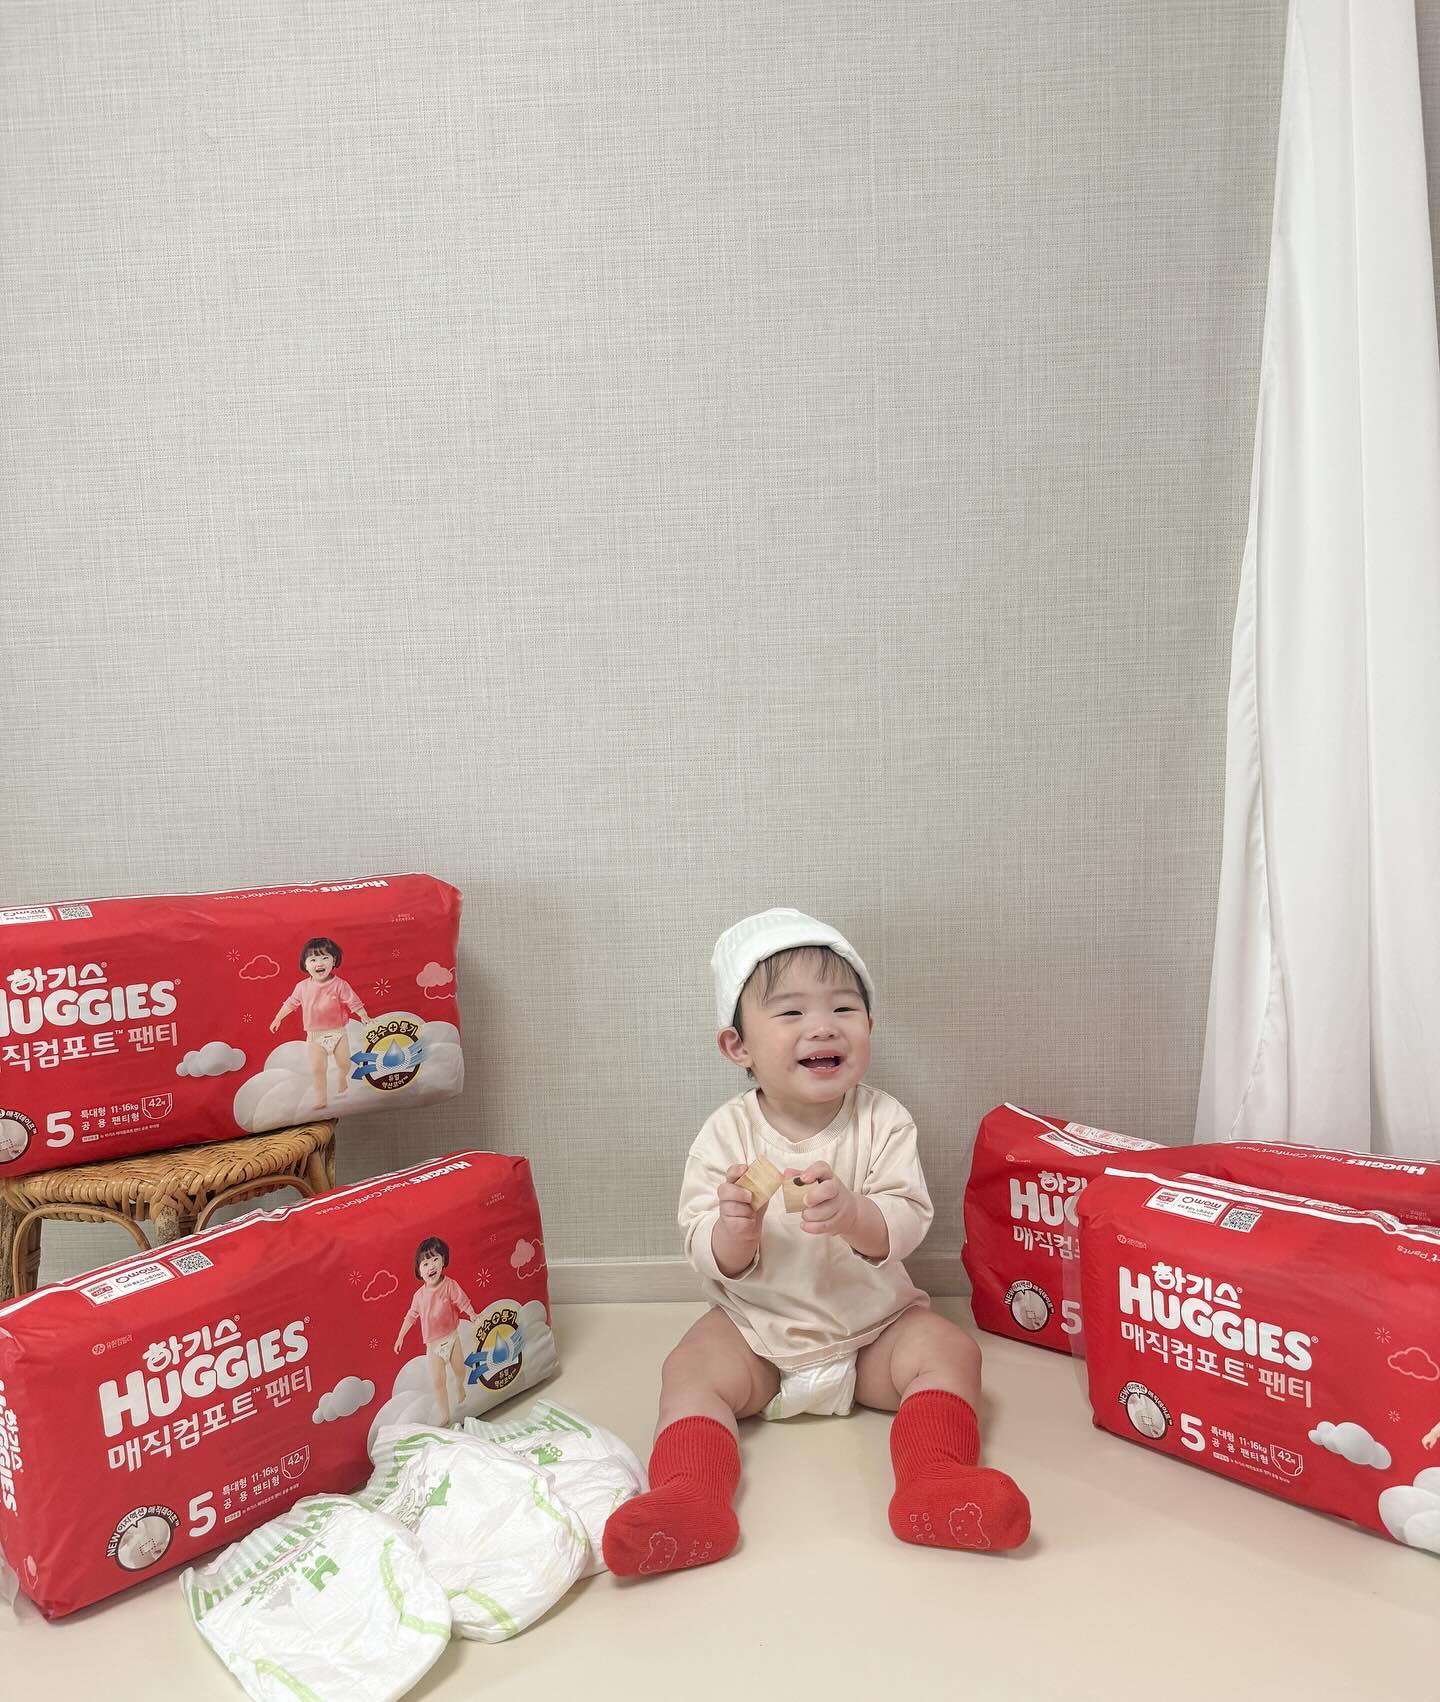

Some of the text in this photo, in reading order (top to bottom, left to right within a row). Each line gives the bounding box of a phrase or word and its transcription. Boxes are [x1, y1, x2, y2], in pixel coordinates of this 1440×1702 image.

[128, 1022, 178, 1053] 팬티
[400, 1021, 418, 1037] 통기
[80, 1103, 139, 1119] 특대형 11-16kg
[111, 1112, 140, 1126] 팬티형
[46, 1111, 75, 1148] 5
[1309, 1153, 1343, 1163] Magic
[1346, 1159, 1427, 1175] HUGGIES
[409, 1160, 473, 1185] HUGGIES
[383, 1182, 409, 1194] Magic
[1396, 1244, 1429, 1259] Pants
[1061, 1299, 1082, 1335] 5
[265, 1365, 313, 1408] 팬티
[1258, 1367, 1312, 1409] 팬티
[1180, 1412, 1206, 1452] 5
[1210, 1425, 1267, 1454] 특대형 11-16kg
[1241, 1447, 1269, 1465] 팬티형
[222, 1465, 279, 1496] 특대형 11-16kg
[253, 1475, 281, 1495] 팬티형
[117, 1507, 145, 1531] 이지액션
[188, 1490, 217, 1538] 5
[106, 1533, 121, 1557] NEW
